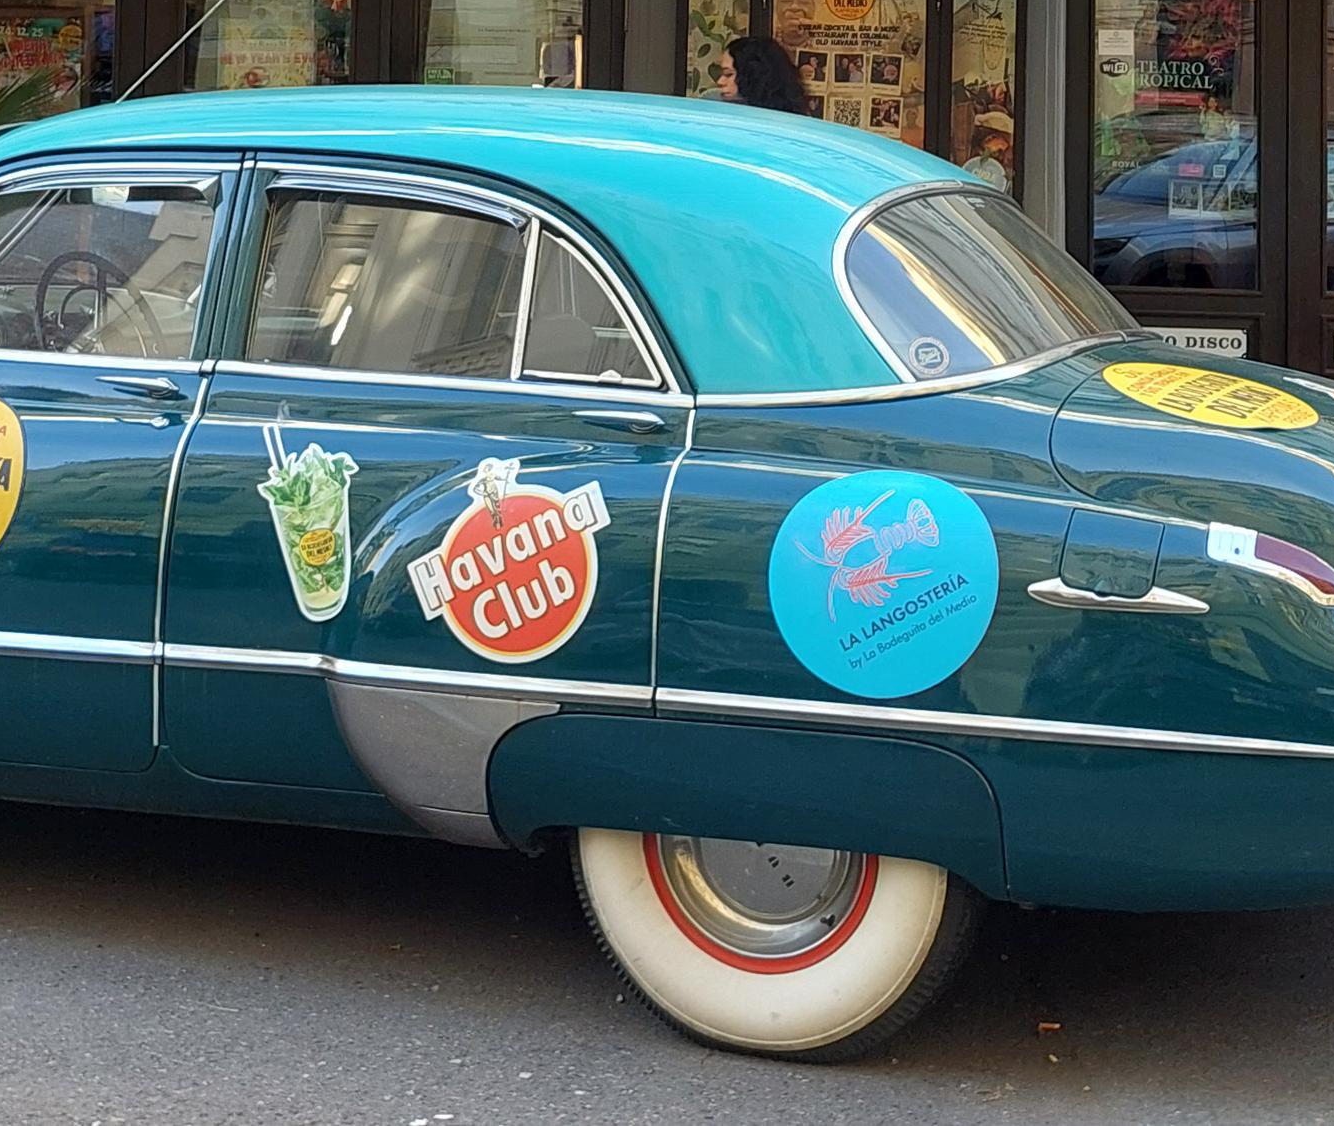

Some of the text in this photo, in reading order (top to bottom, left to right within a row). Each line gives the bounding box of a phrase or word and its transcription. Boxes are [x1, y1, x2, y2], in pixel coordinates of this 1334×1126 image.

[1137, 60, 1204, 76] TEATRO
[1139, 73, 1213, 90] ROPICAL
[1185, 335, 1242, 350] DISCO
[415, 490, 600, 611] Havana
[472, 557, 576, 640] Club
[838, 573, 970, 652] LA LANGOSTERÍA
[848, 594, 977, 670] by La Bodeguita del Medio
